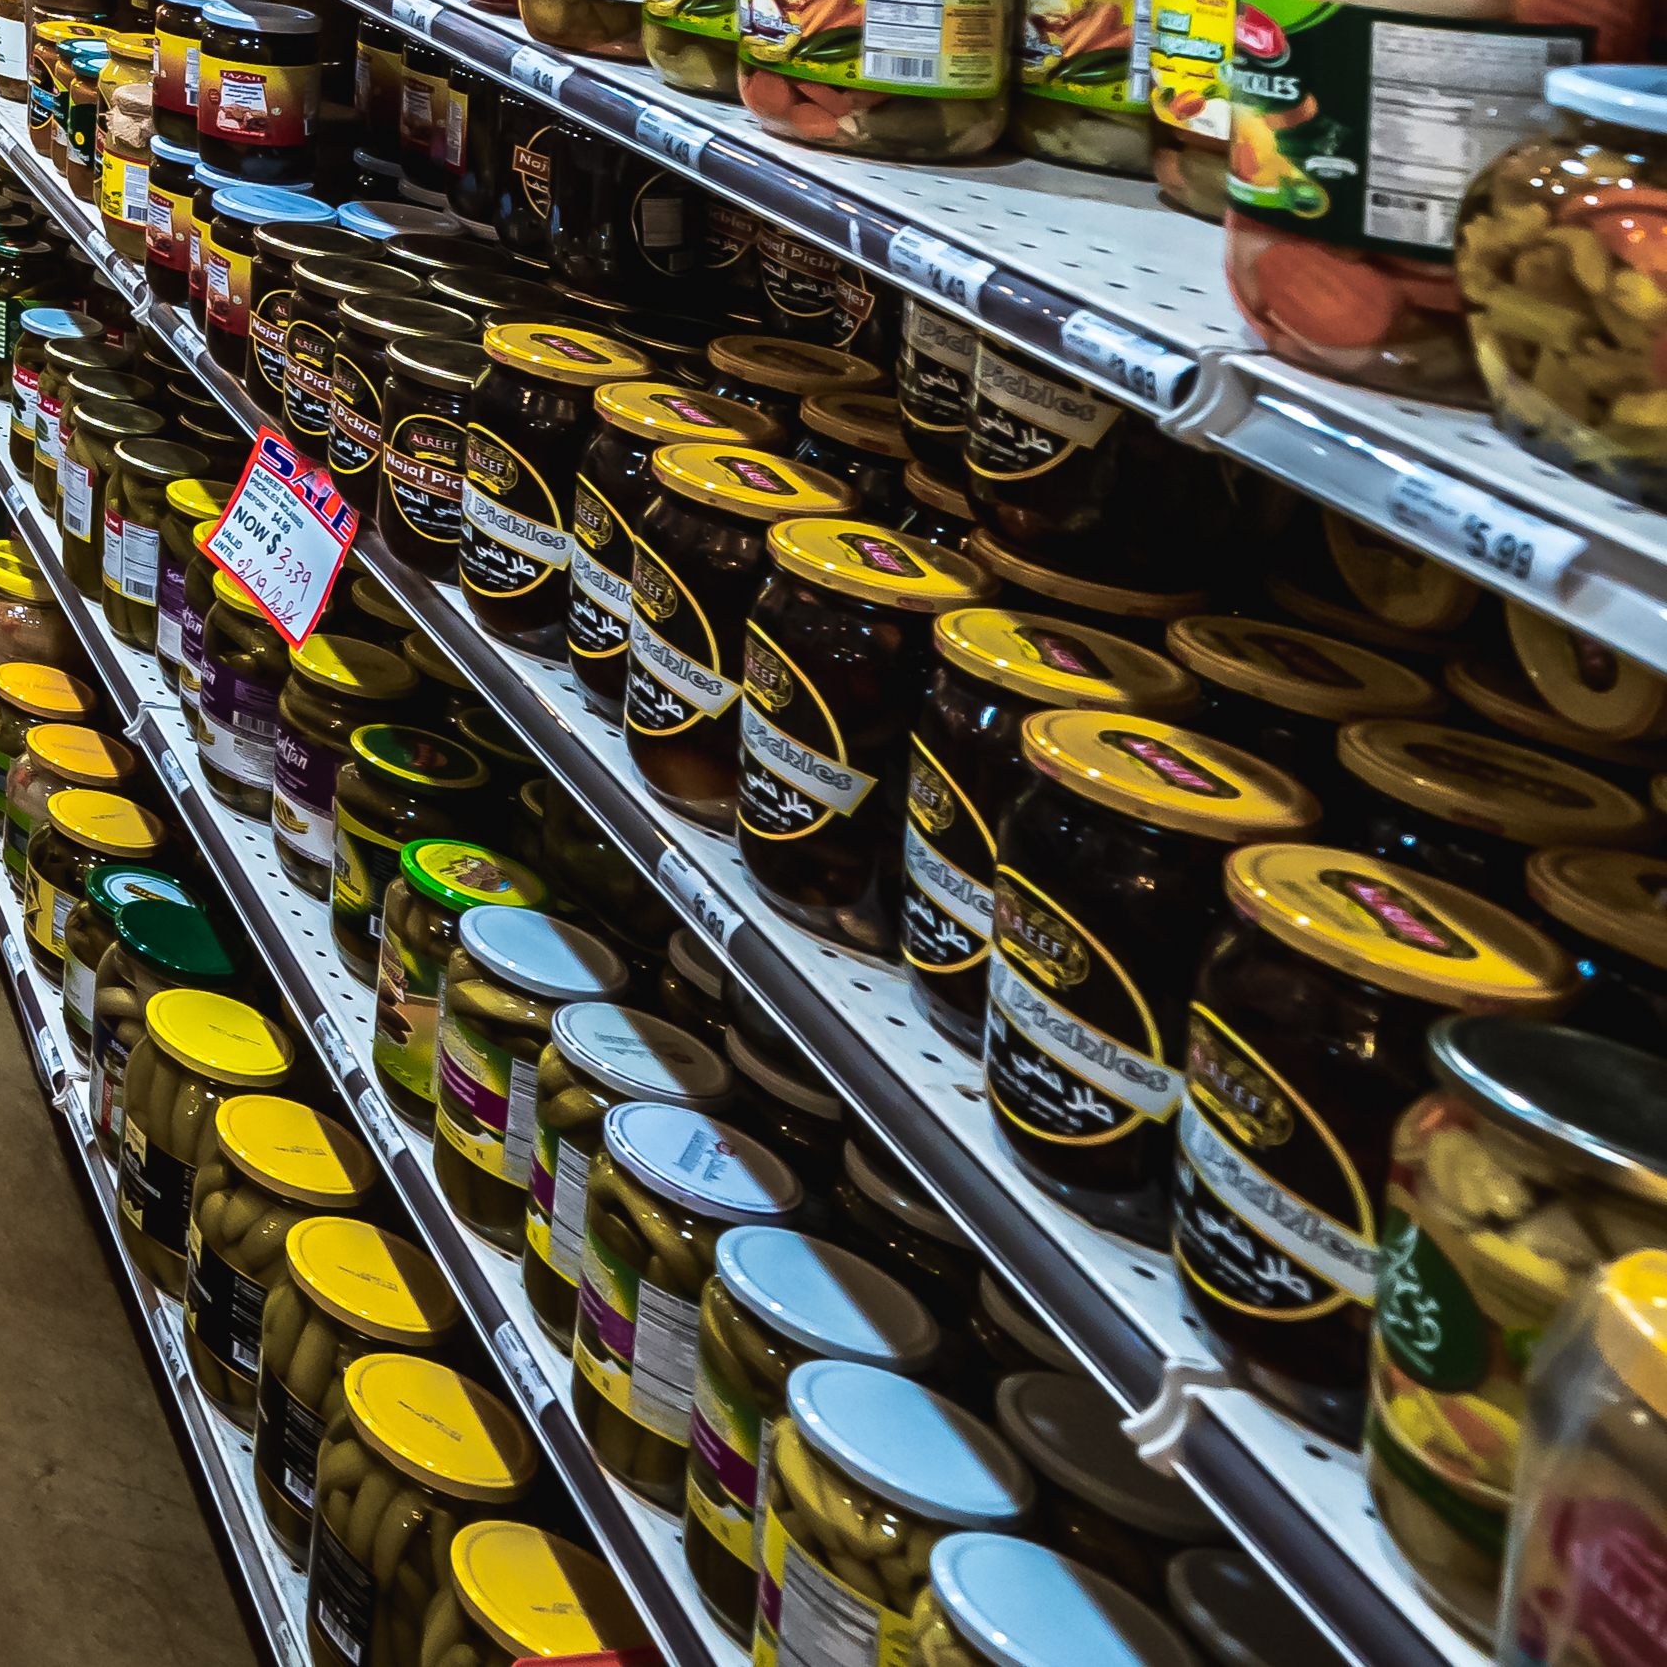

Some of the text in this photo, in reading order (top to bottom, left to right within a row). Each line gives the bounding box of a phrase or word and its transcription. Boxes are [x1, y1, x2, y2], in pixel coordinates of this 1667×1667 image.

[251, 318, 284, 343] Najaf
[411, 433, 458, 451] ALREEF
[254, 469, 283, 492] ALREEF
[386, 453, 426, 483] Najaf
[243, 490, 268, 512] BEFORE
[249, 477, 281, 504] PICKLES
[259, 437, 352, 543] SALE
[232, 506, 282, 556] NOW $
[475, 497, 567, 551] Pickles
[213, 539, 235, 561] UNTIL
[221, 527, 243, 550] VALID
[635, 620, 723, 695] Pickles
